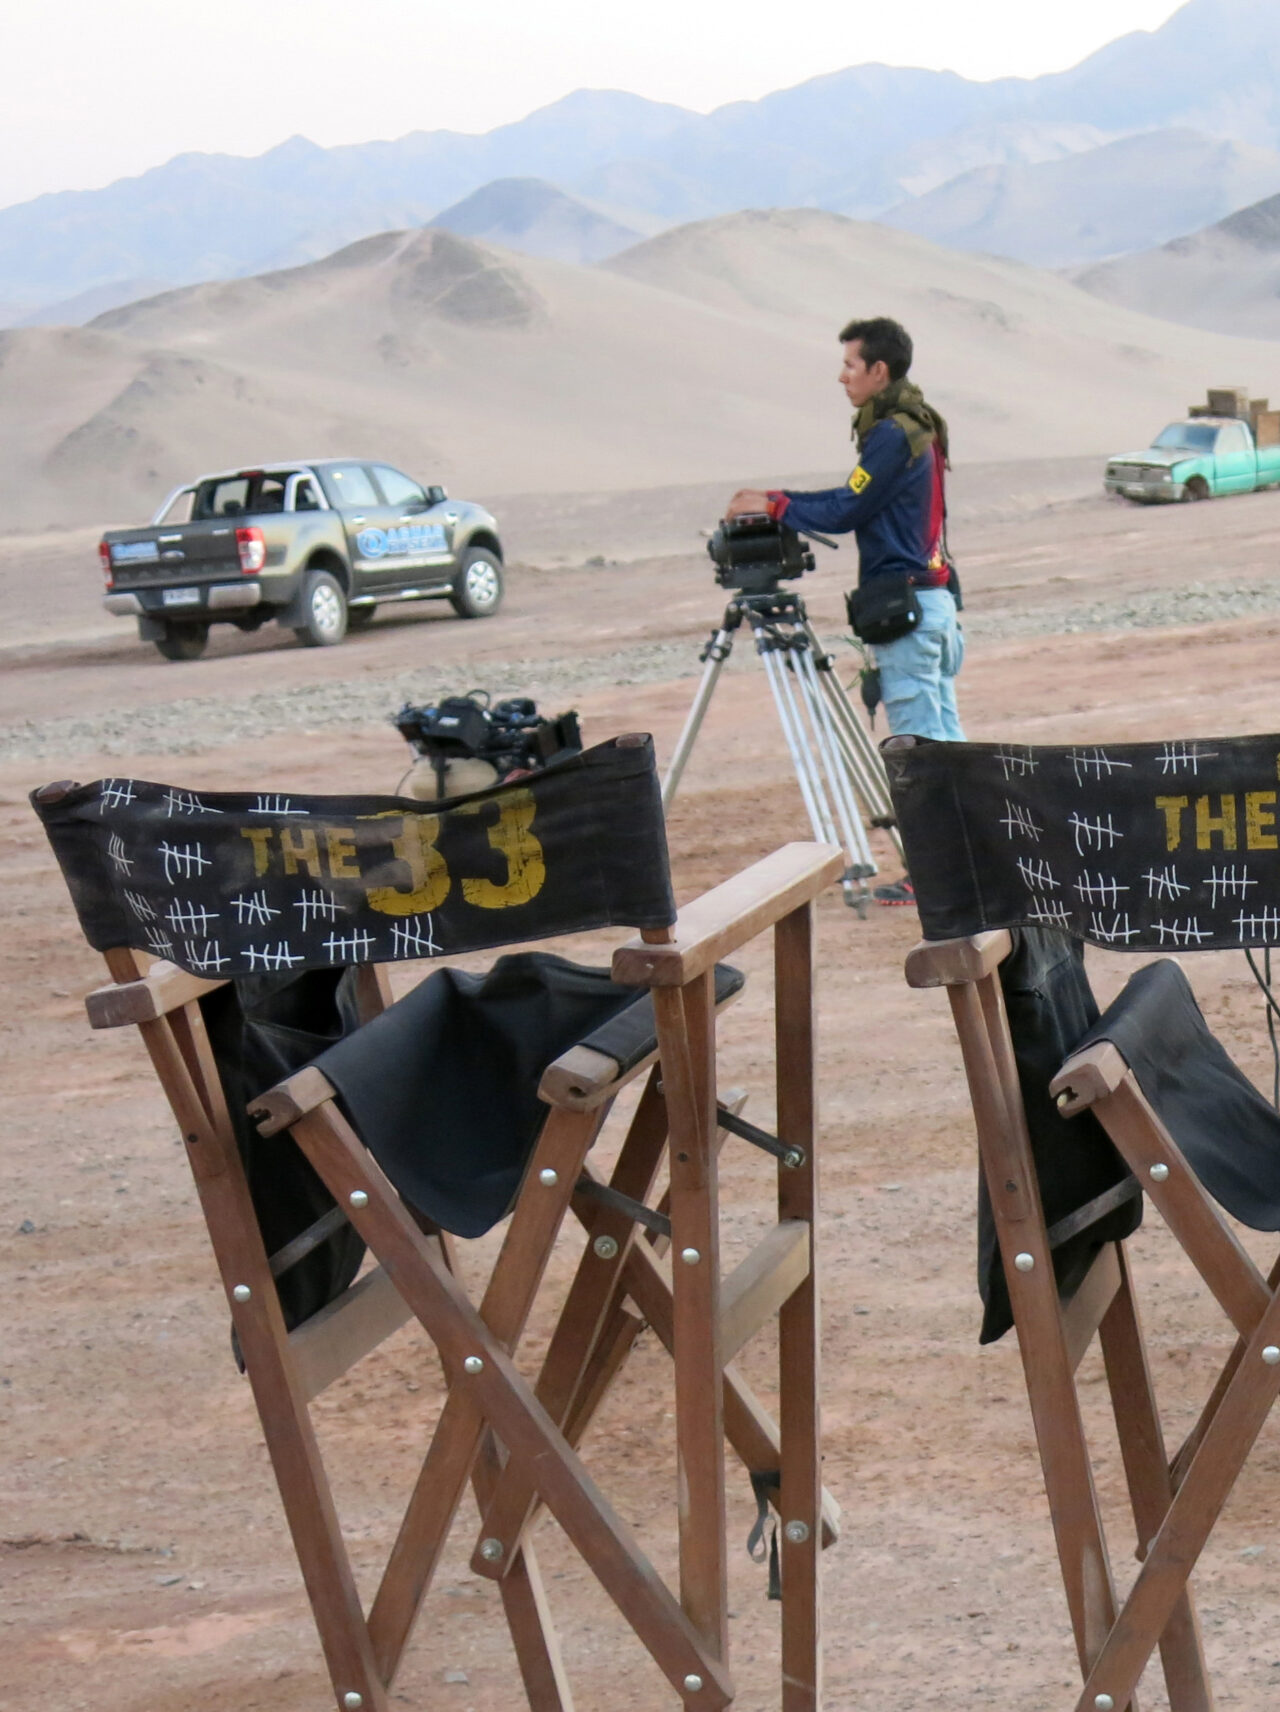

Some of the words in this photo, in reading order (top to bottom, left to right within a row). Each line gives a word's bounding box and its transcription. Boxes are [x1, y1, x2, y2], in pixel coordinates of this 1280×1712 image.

[241, 827, 361, 878] THE
[355, 788, 546, 916] 33
[1155, 791, 1278, 851] THE
